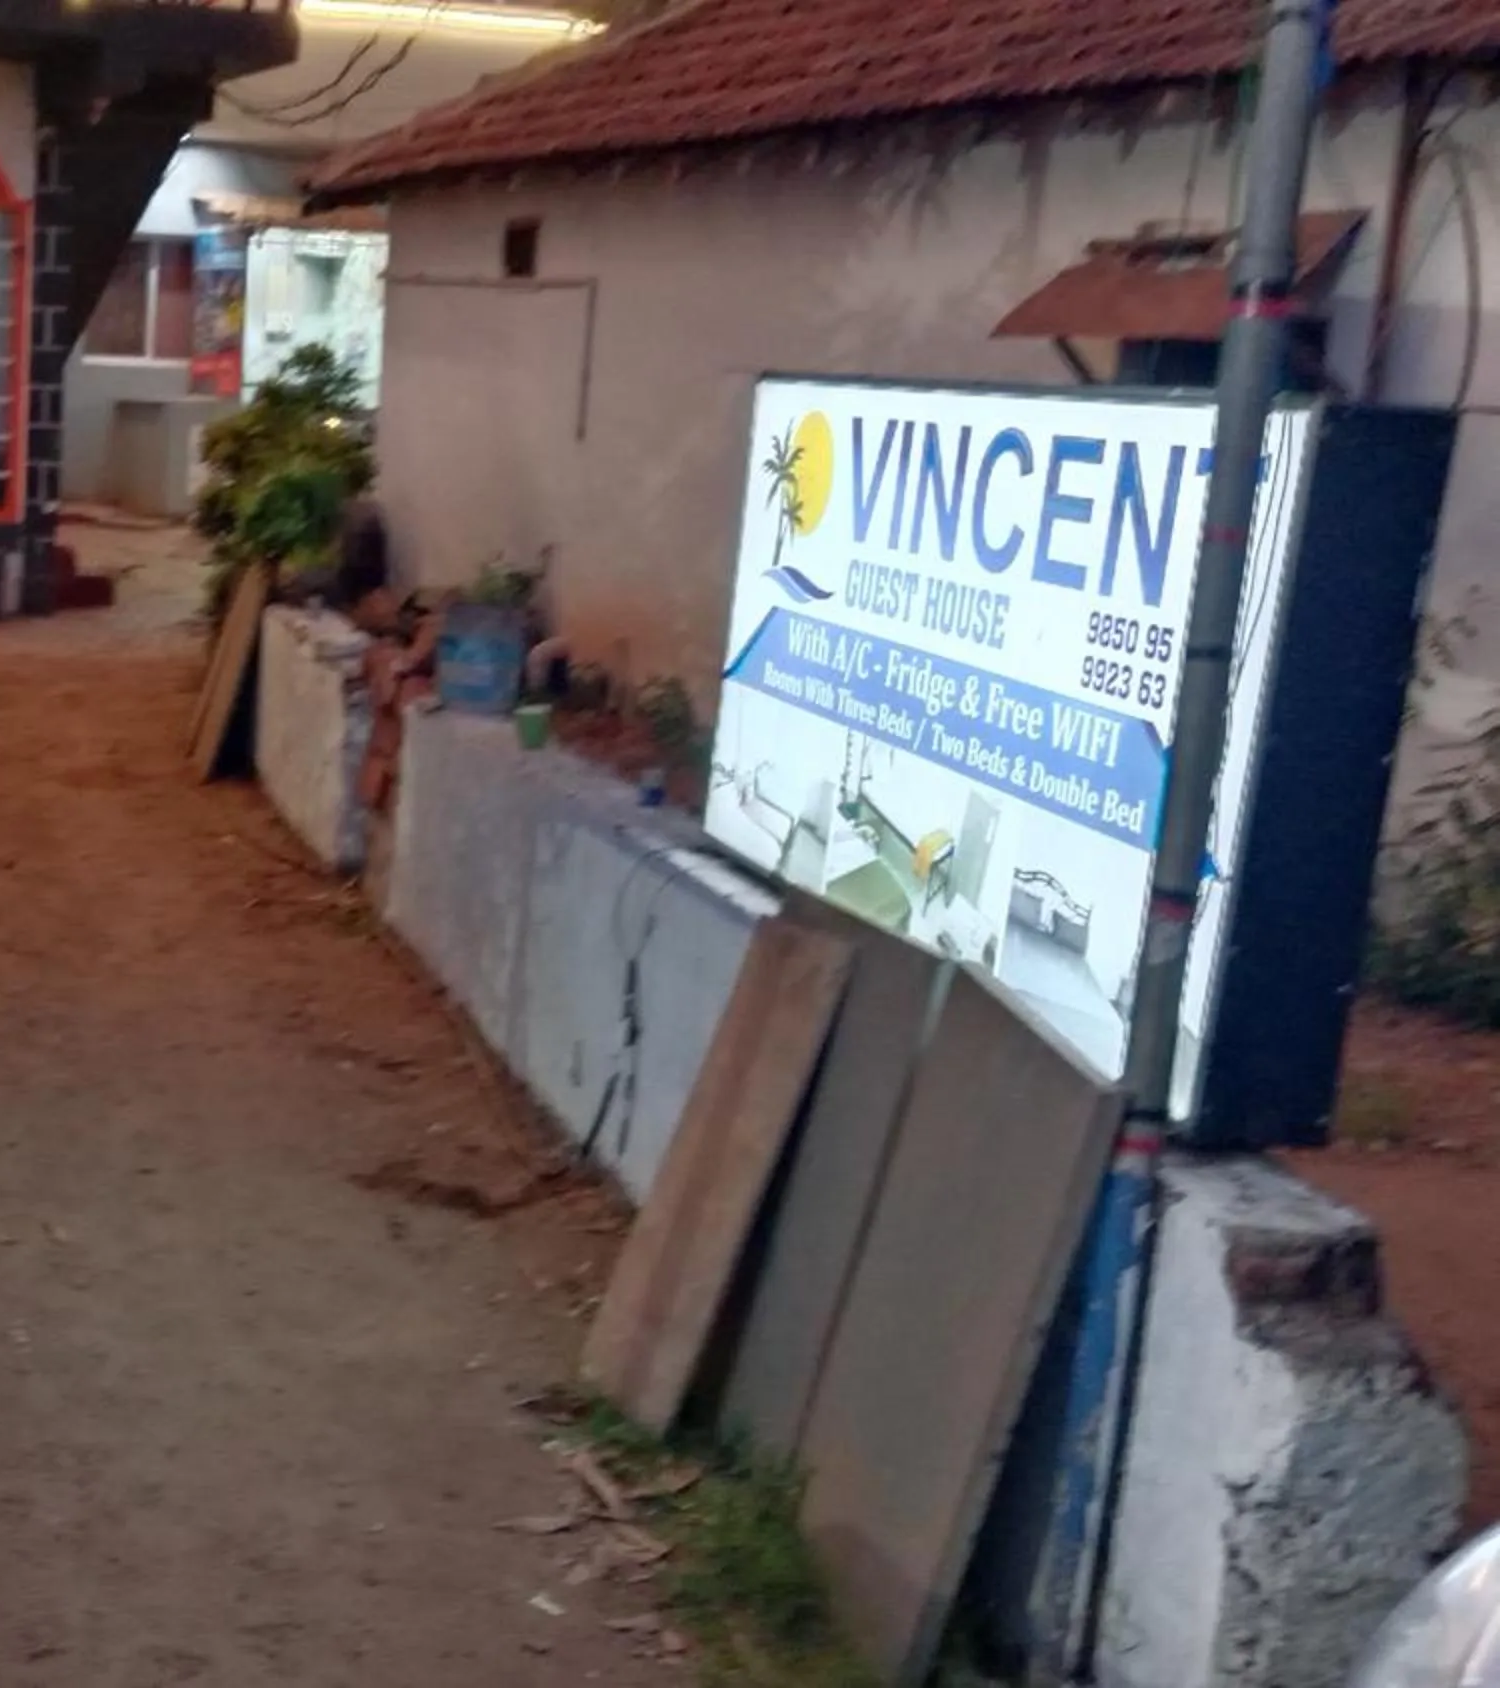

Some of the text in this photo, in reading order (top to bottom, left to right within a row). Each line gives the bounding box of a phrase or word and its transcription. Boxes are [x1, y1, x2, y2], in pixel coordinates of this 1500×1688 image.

[845, 559, 1011, 650] GUEST HOUSE
[1086, 611, 1174, 663] 9850 95
[789, 618, 829, 668] With
[831, 634, 873, 684] A/C
[885, 649, 956, 716] Fridge
[959, 675, 981, 718] &
[984, 681, 1044, 740] Free
[1051, 701, 1123, 768] WIFI
[1080, 655, 1167, 709] 9923 63
[763, 660, 803, 697] Rooms
[805, 675, 835, 710] With
[837, 688, 876, 725] Three
[877, 702, 913, 740] Beds
[931, 721, 966, 762] Two
[966, 736, 1010, 779] Beds
[1010, 754, 1027, 786] &
[1029, 760, 1099, 816] Double
[1102, 788, 1146, 834] Bed
